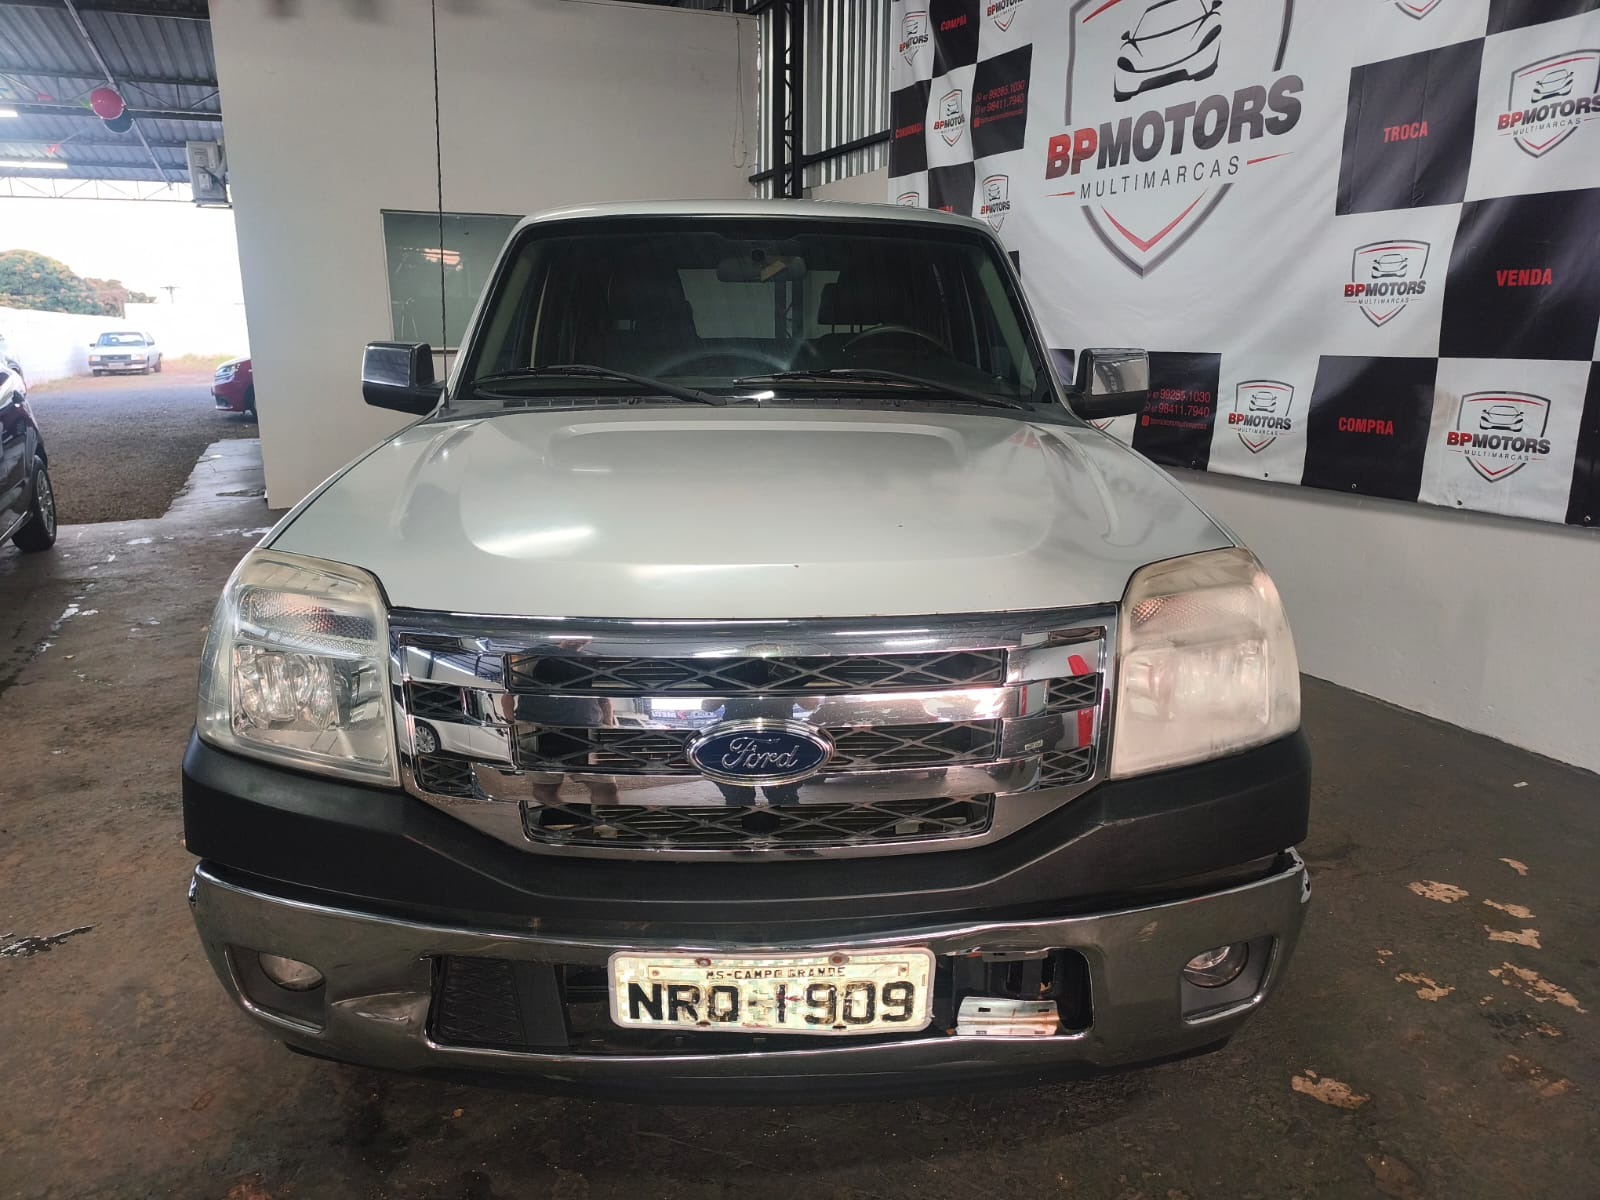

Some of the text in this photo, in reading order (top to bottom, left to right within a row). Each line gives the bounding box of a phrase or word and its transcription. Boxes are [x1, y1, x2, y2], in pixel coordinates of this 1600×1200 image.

[1045, 75, 1304, 180] BPMOTORS
[1383, 121, 1428, 144] TROCA
[1512, 117, 1581, 136] MULTIMARCAS
[1080, 156, 1240, 200] MULTIMARCAS
[1496, 268, 1553, 287] VENDA
[1344, 280, 1427, 297] BPMOTORS
[1358, 297, 1410, 305] MULTIMARCAS
[1158, 402, 1210, 418] 98411.7940
[1228, 413, 1292, 430] BPMOTORS
[1338, 416, 1394, 436] COMPRA
[1446, 431, 1551, 455] BPMOTORS
[1464, 449, 1530, 461] MULTIMARCAS
[721, 736, 800, 769] Ford
[787, 966, 846, 978] GRANDE
[777, 980, 916, 1025] 1909
